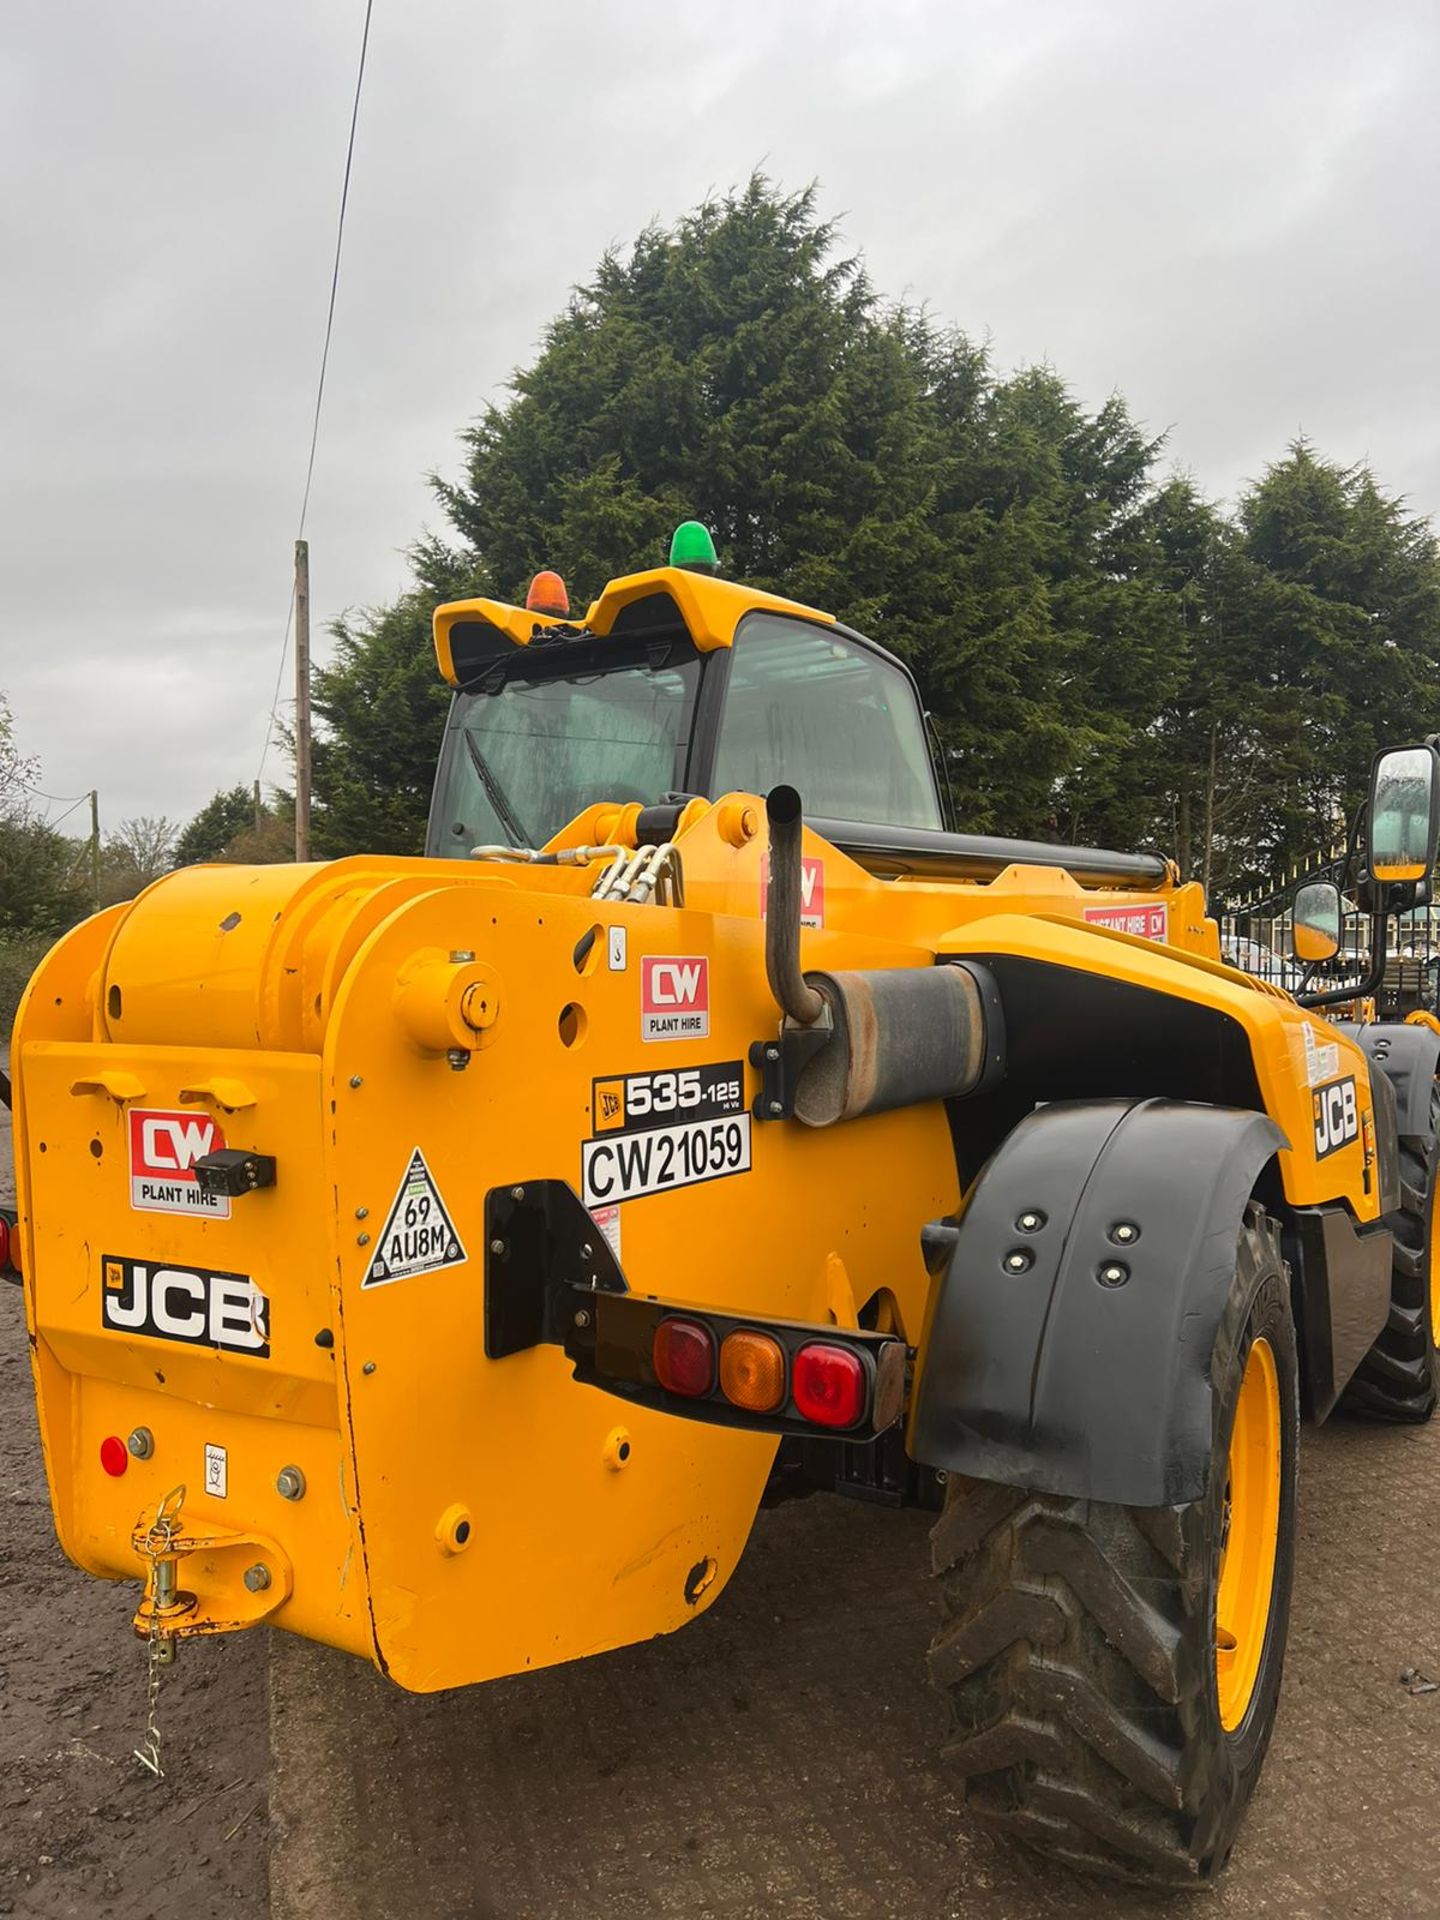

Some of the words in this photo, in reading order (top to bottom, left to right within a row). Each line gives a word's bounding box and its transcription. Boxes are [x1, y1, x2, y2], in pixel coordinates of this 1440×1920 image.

[1127, 915, 1146, 934] HIRE
[651, 963, 701, 1005] CW
[649, 1019, 679, 1033] PLANT
[681, 1017, 702, 1030] HIRE
[603, 1094, 620, 1117] JCB
[1315, 1080, 1359, 1154] JCB
[143, 1119, 214, 1170] CW
[588, 1122, 743, 1200] CW21059
[142, 1184, 182, 1202] PLANT
[187, 1189, 218, 1207] HIRE
[405, 1195, 431, 1228] 69
[389, 1224, 445, 1265] AU8M
[105, 1266, 266, 1348] JCB
